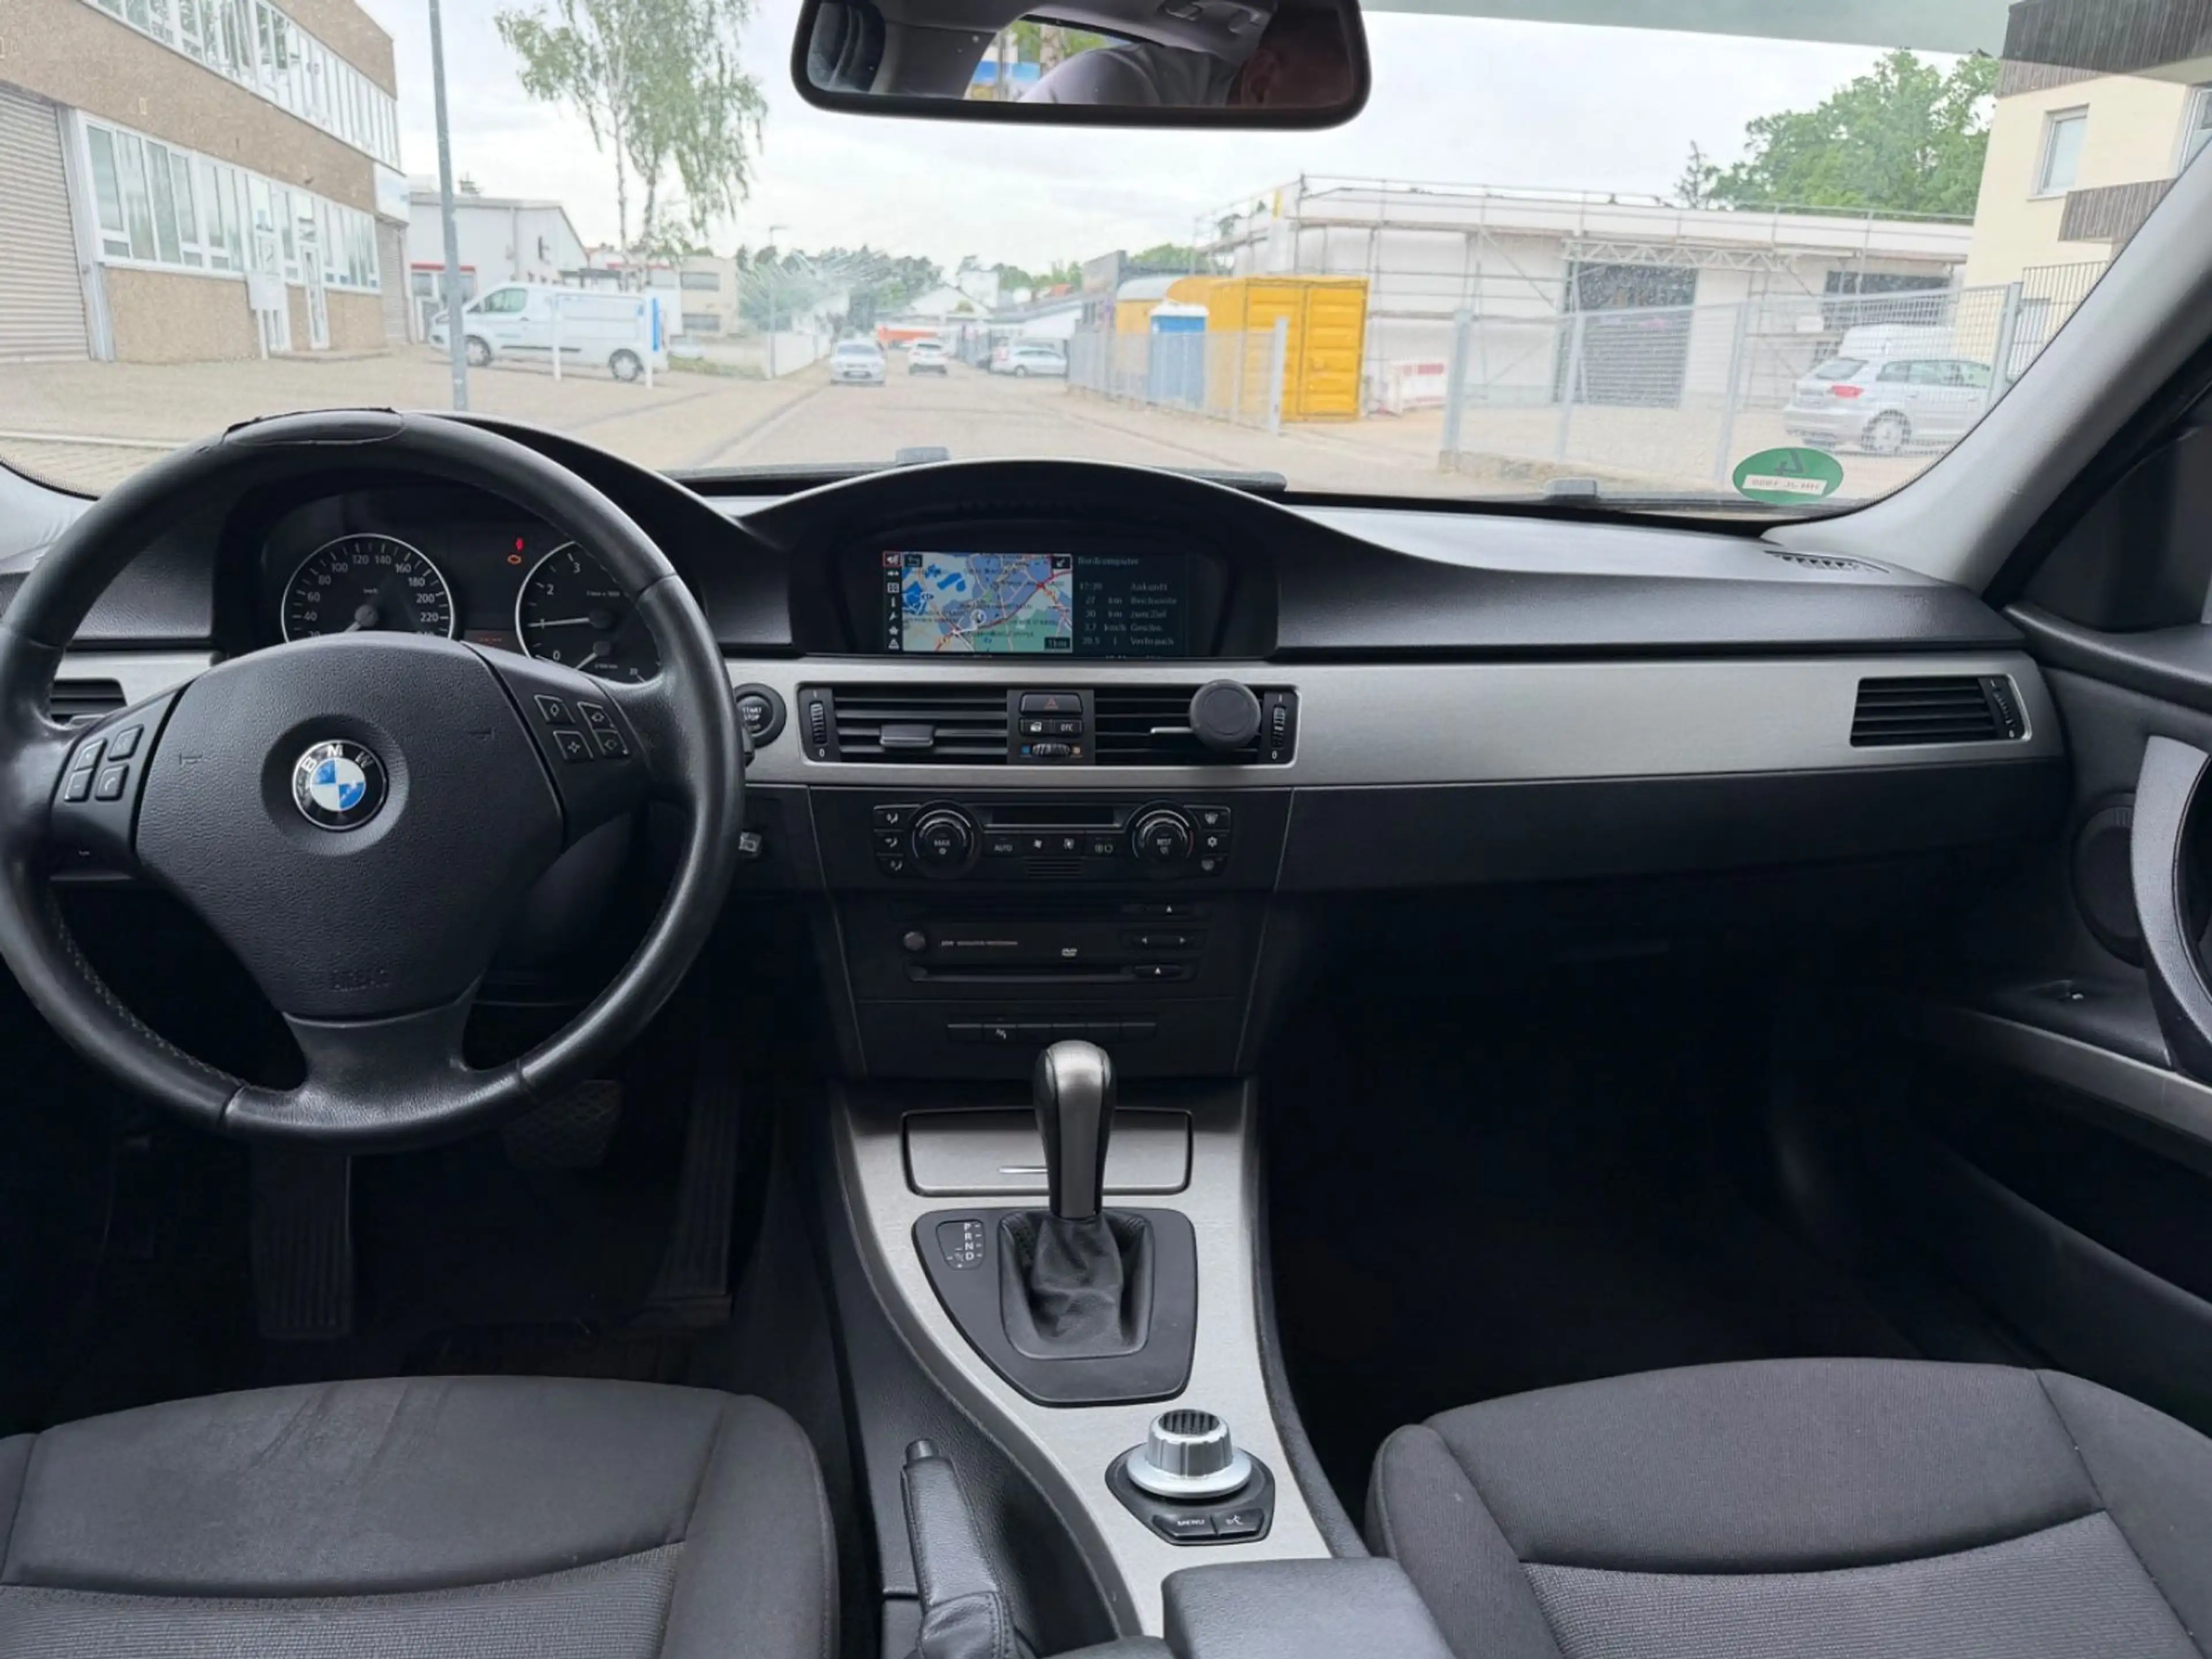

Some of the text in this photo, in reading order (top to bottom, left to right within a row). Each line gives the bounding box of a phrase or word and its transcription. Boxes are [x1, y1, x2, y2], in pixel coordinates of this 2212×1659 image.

[353, 555, 369, 565] 120
[376, 555, 392, 565] 140
[332, 563, 348, 573] 100
[395, 564, 411, 573] 160
[574, 563, 581, 573] 3
[319, 575, 331, 585] 80
[409, 578, 425, 587] 180
[547, 584, 554, 595] 2
[308, 592, 320, 603] 60
[416, 594, 435, 603] 200
[304, 612, 317, 622] 40
[421, 612, 439, 622] 220
[553, 650, 560, 660] 0
[301, 745, 374, 772] BMW
[993, 844, 1013, 853] AUTO
[964, 1222, 972, 1231] P
[965, 1233, 972, 1241] R
[965, 1242, 974, 1251] N
[965, 1252, 974, 1260] D
